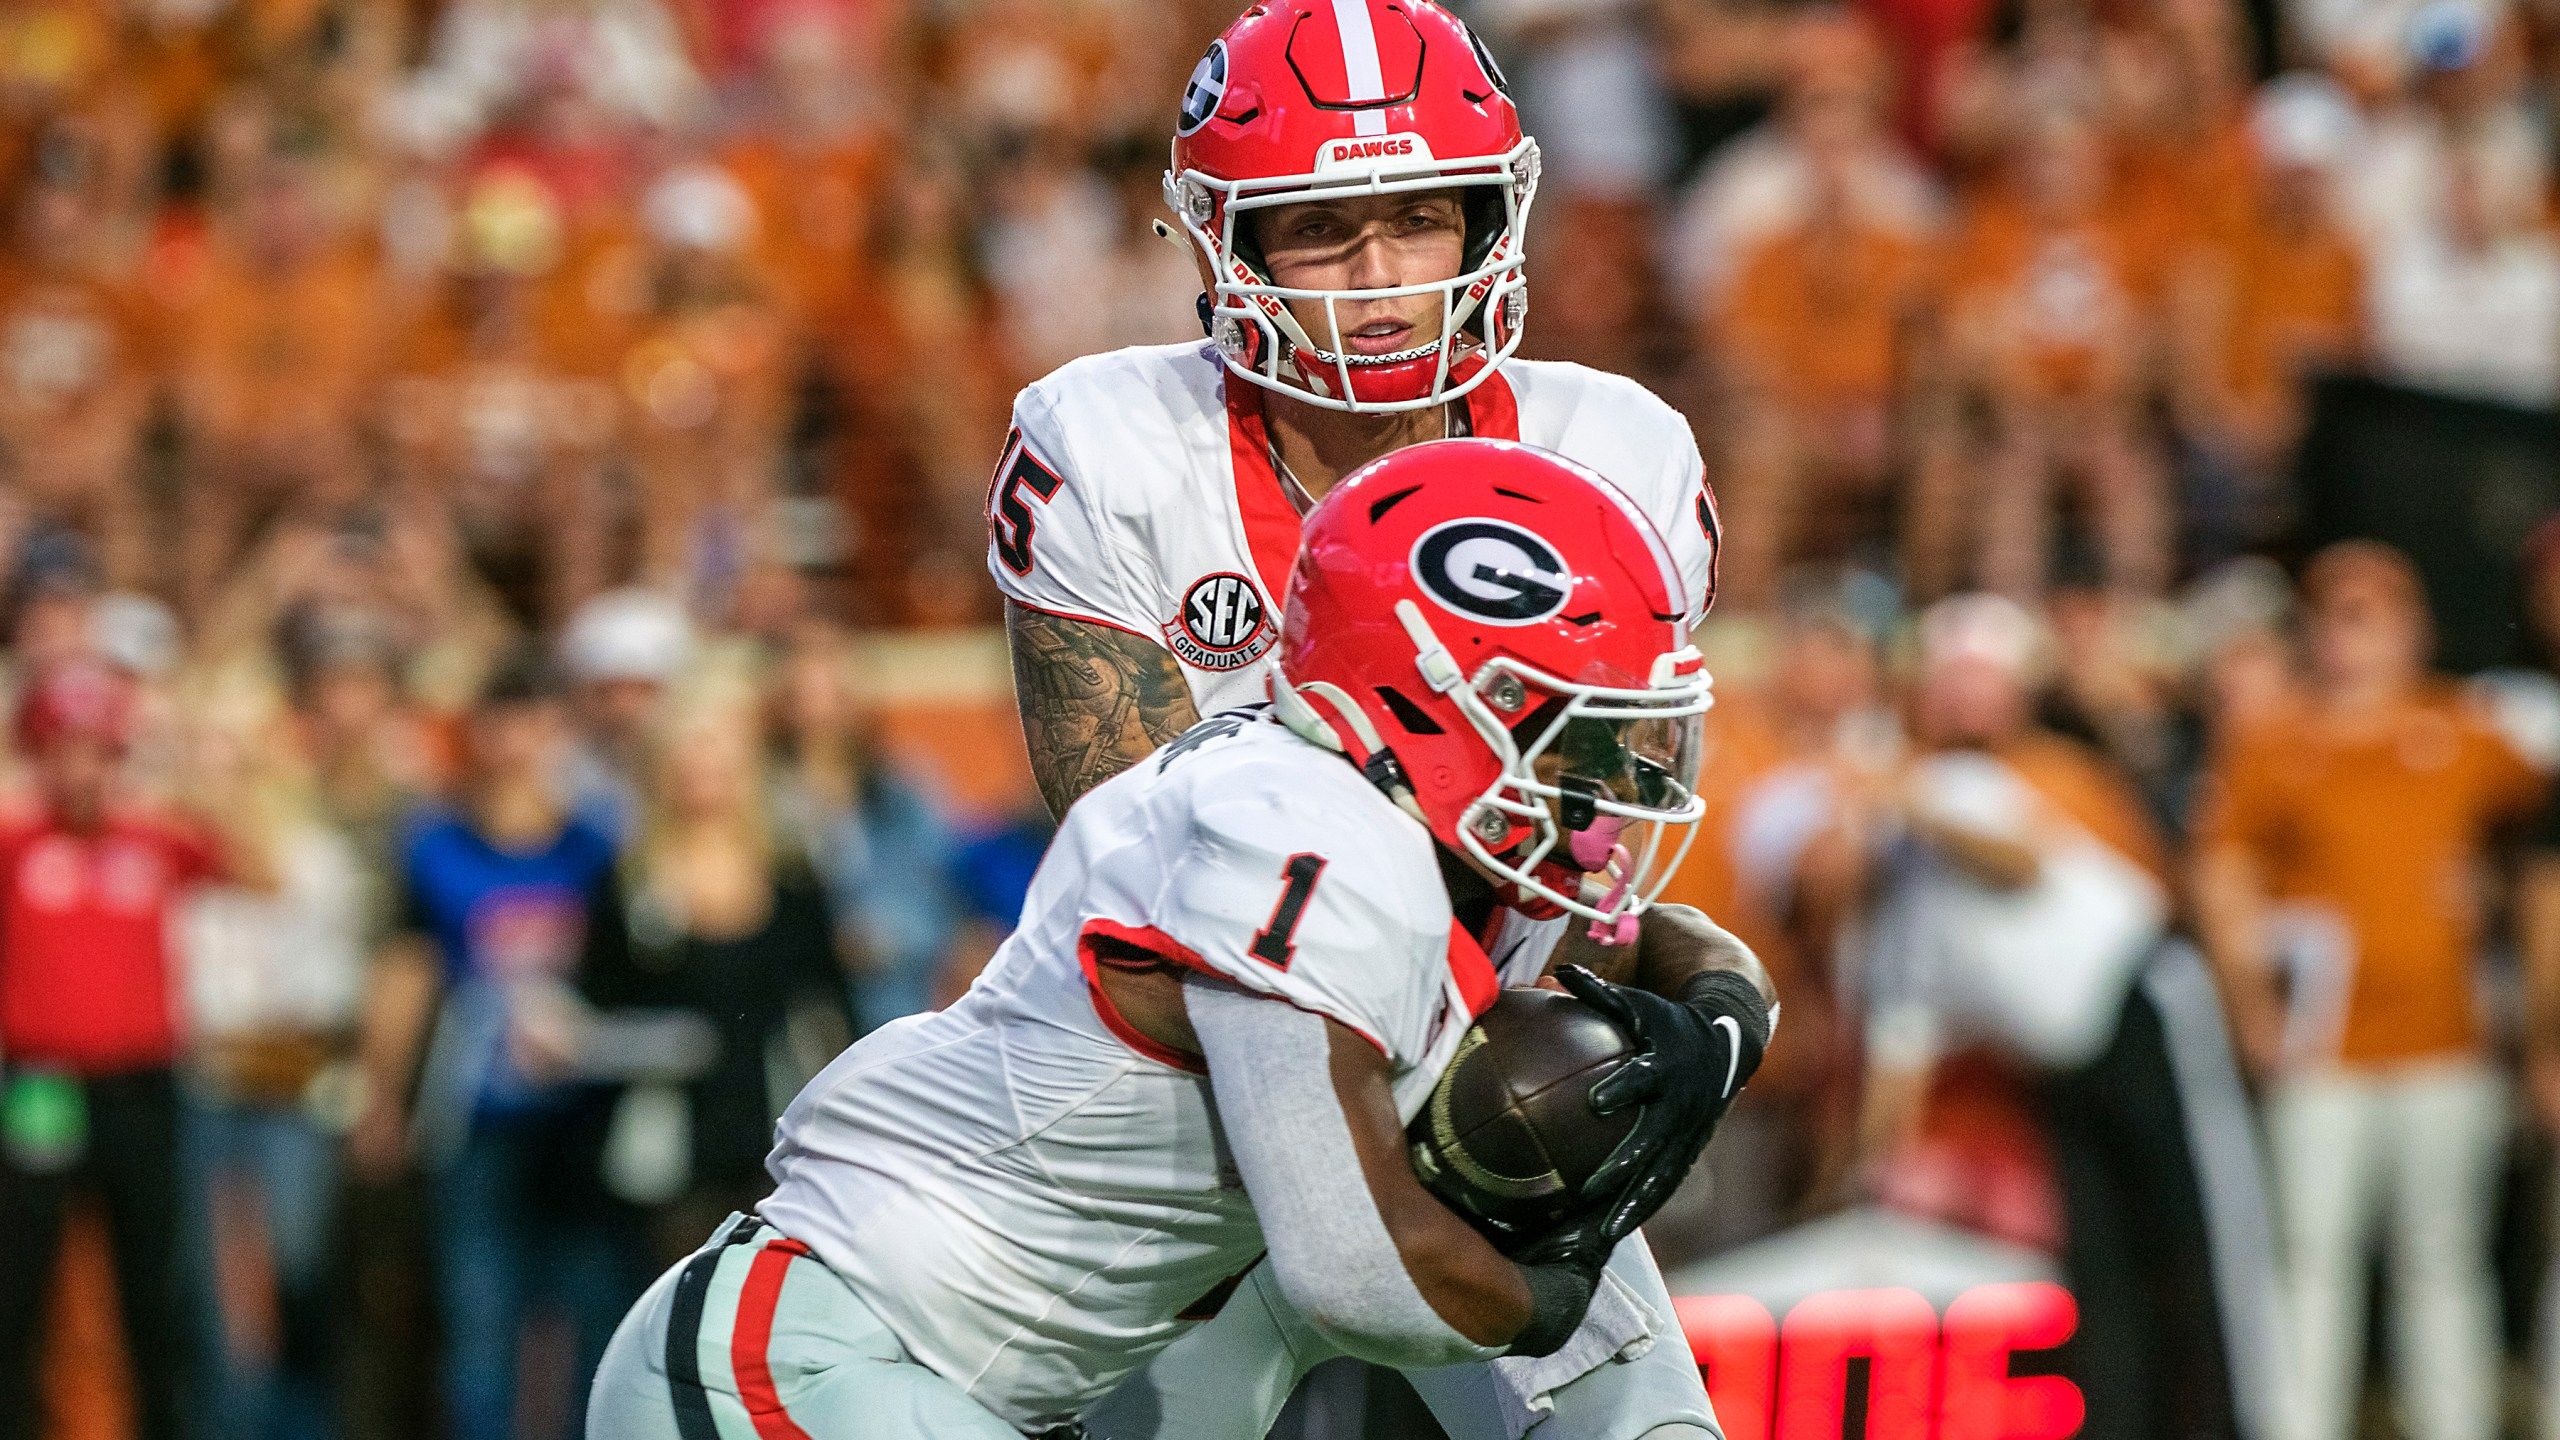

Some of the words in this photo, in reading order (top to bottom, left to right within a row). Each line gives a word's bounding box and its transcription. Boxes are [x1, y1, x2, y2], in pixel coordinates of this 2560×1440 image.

[1333, 139, 1413, 162] DAWGS
[1416, 521, 1566, 621] G
[1190, 578, 1259, 646] SEC
[1175, 636, 1262, 668] GRADUATE
[1248, 852, 1329, 973] 1
